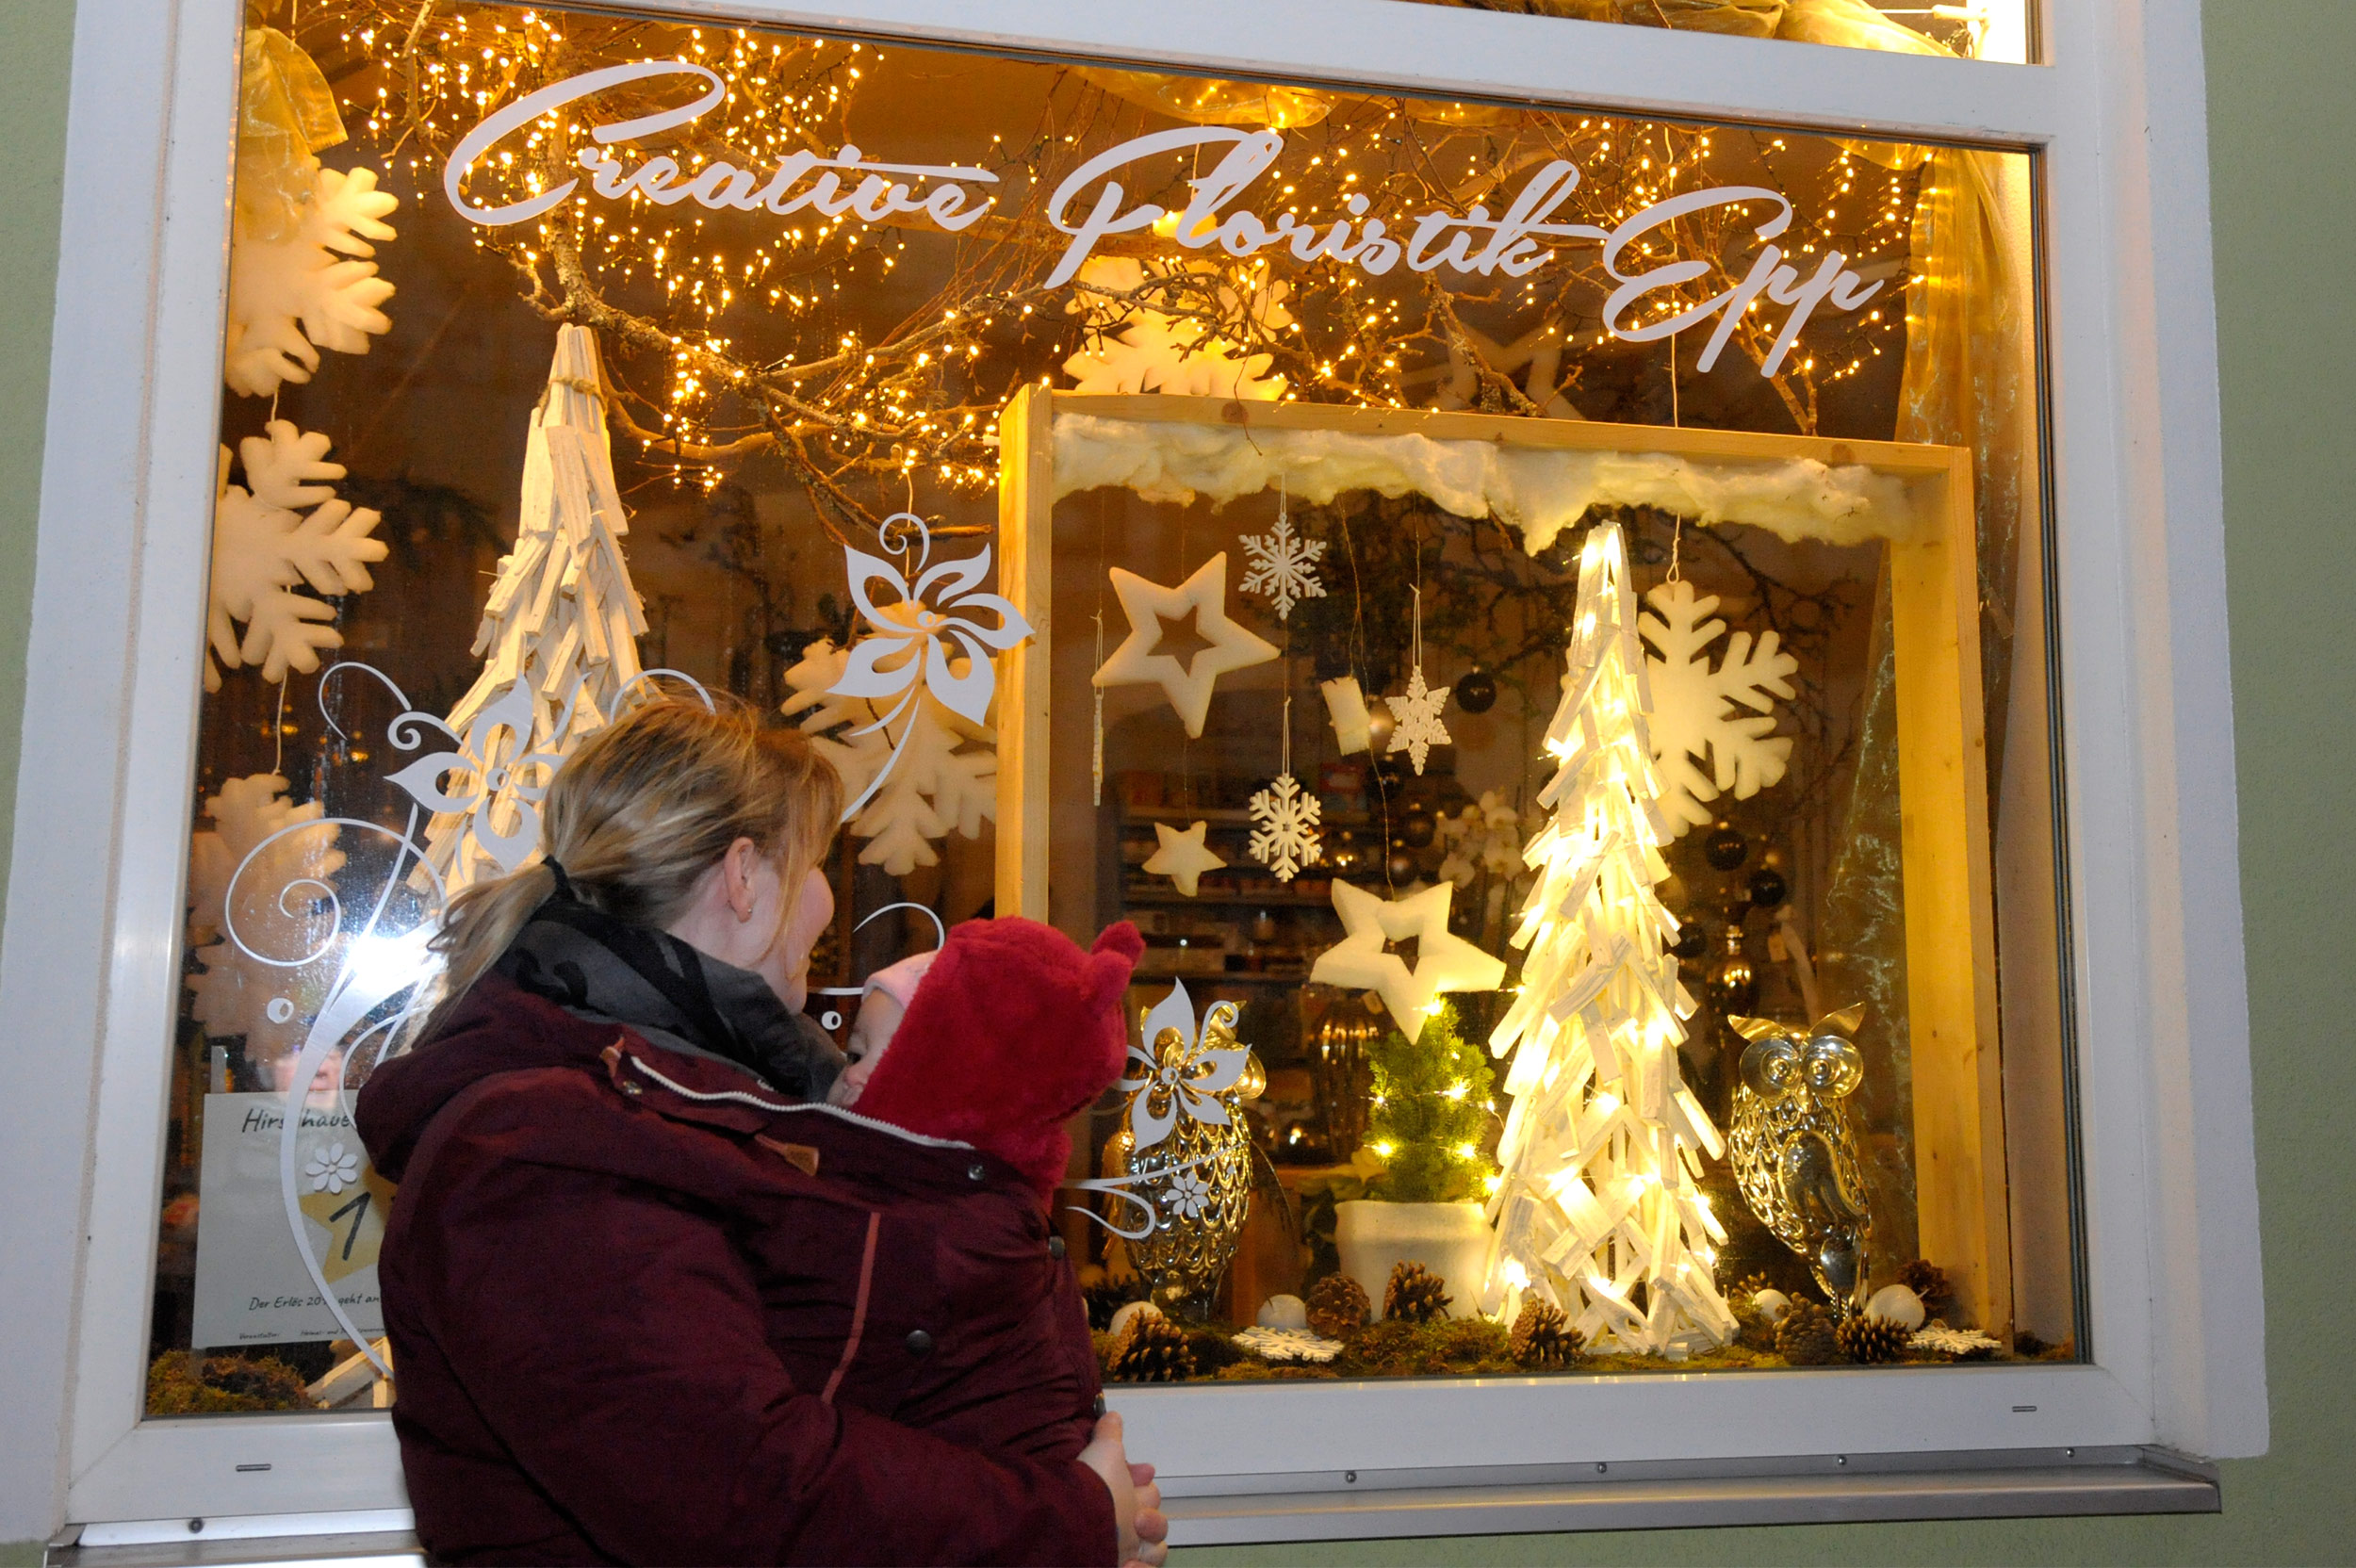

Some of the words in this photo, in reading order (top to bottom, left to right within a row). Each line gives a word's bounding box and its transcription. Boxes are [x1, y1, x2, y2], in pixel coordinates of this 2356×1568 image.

[444, 59, 1000, 232] Creative
[1044, 125, 1609, 290] Floristik
[1602, 186, 1884, 377] Epp
[249, 1297, 270, 1311] Der
[337, 1293, 362, 1307] geht
